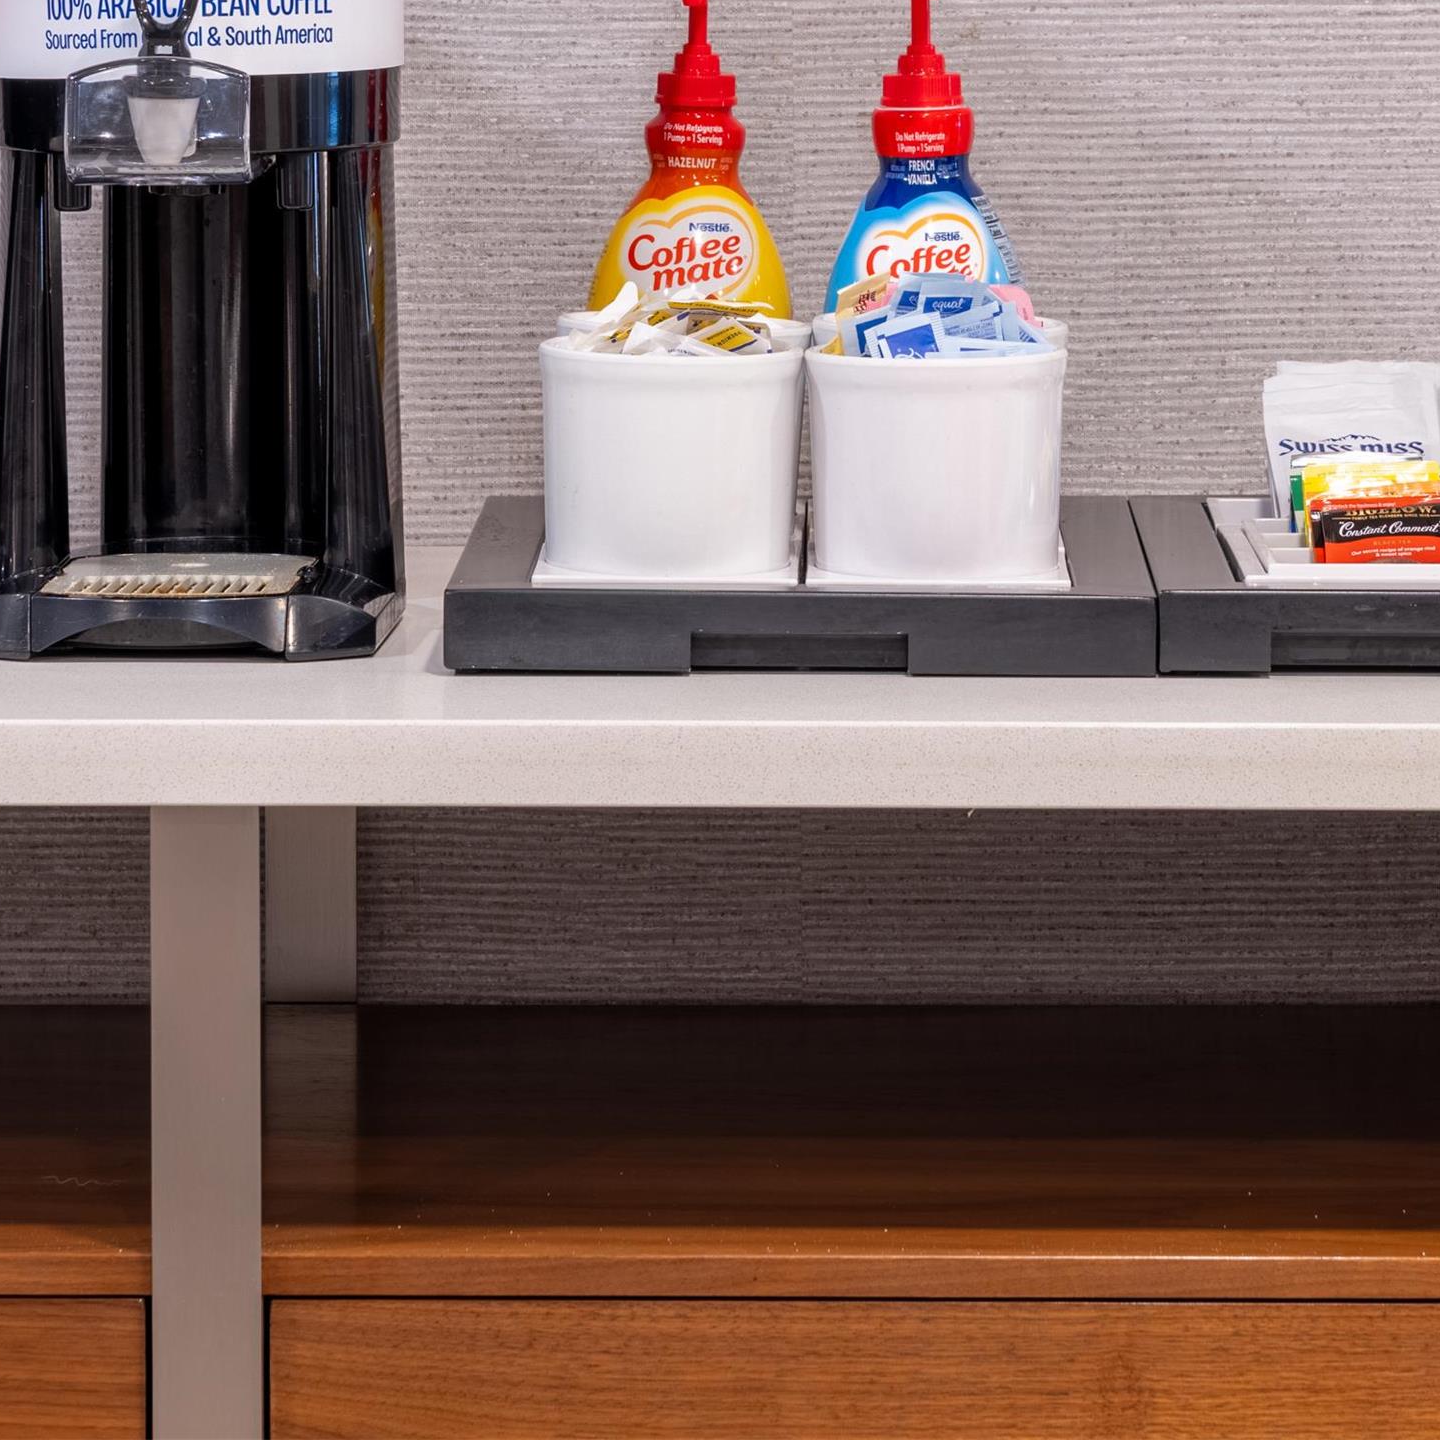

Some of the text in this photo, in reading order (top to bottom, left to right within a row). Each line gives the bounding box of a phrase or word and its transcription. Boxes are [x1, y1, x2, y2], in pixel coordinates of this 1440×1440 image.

[45, 29, 97, 50] Sourced
[100, 29, 138, 48] From
[207, 27, 221, 47] &
[225, 25, 271, 46] South
[275, 23, 333, 45] America
[668, 132, 685, 144] Pump
[697, 134, 722, 146] Serving
[895, 132, 945, 143] Do Not Refrigerate
[901, 143, 916, 154] Pump
[924, 143, 945, 154] Serving
[668, 156, 717, 169] HAZELNUT
[909, 160, 935, 172] FRENCH
[908, 174, 937, 185] VANILLA
[628, 234, 741, 271] Coffee
[866, 243, 971, 279] Coffee
[653, 255, 744, 291] mate
[932, 298, 964, 311] equal
